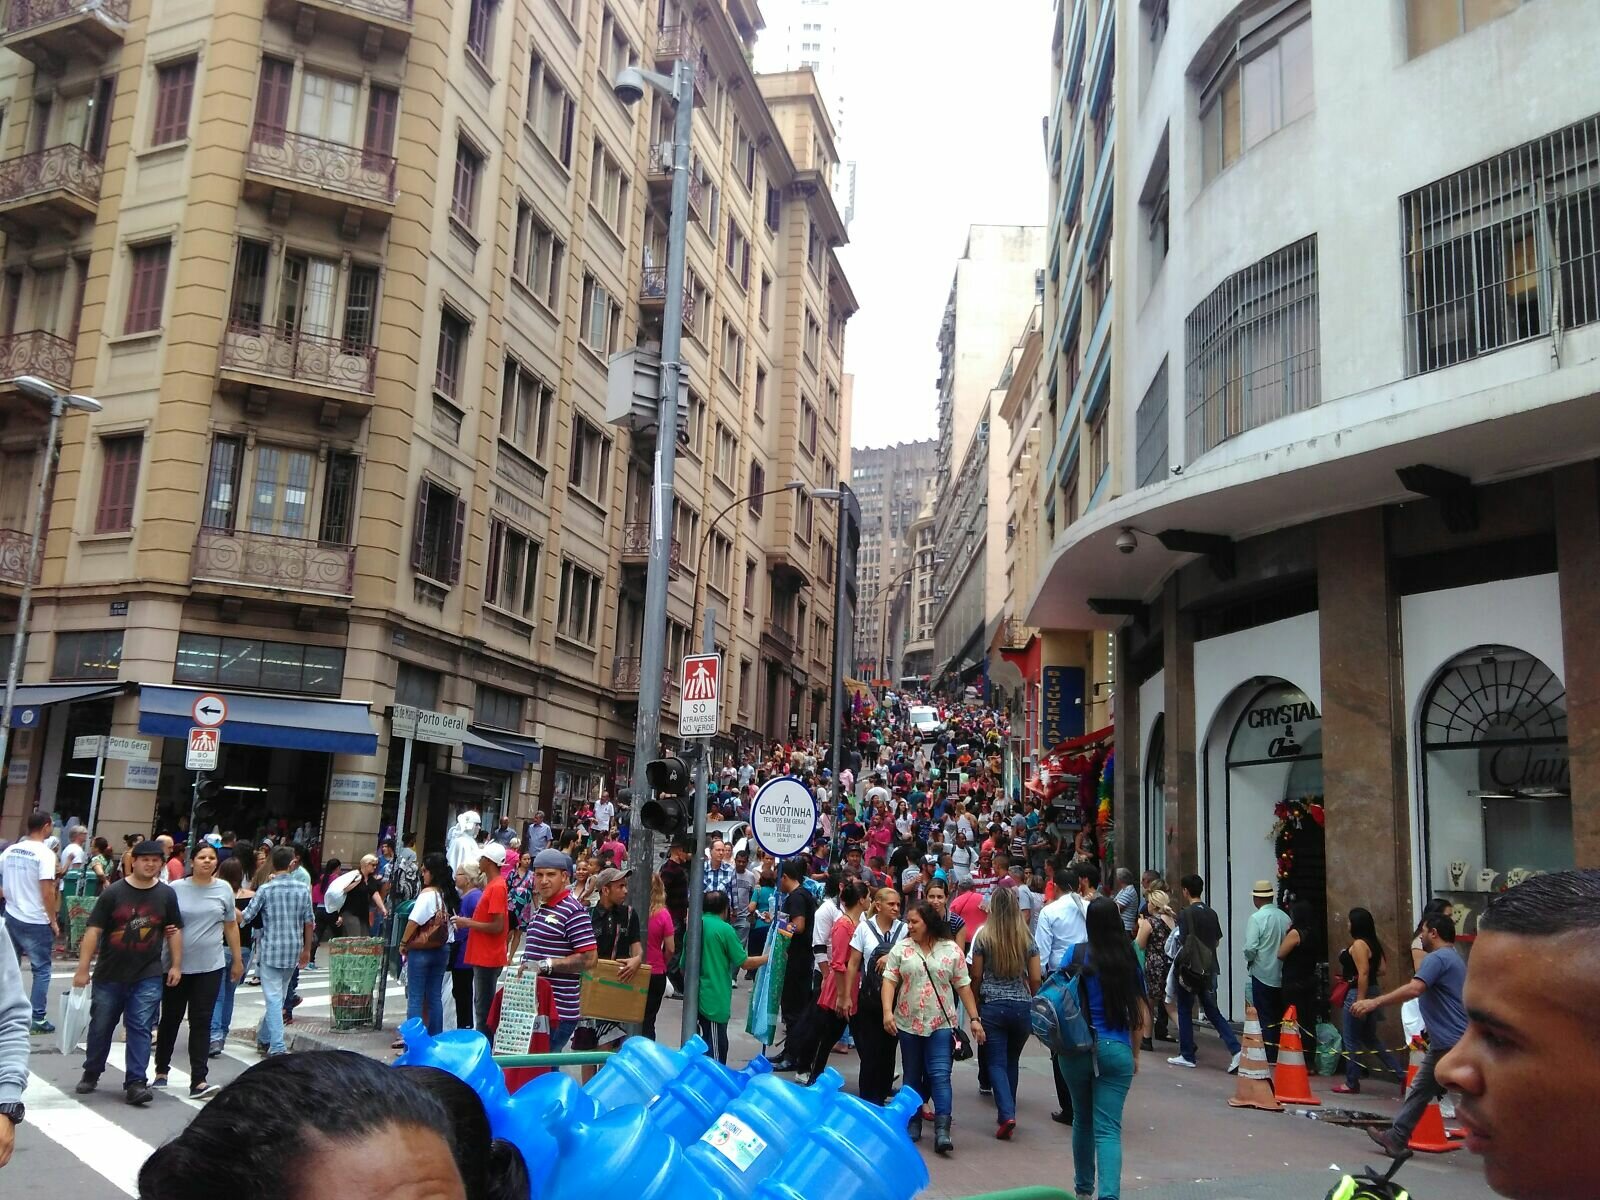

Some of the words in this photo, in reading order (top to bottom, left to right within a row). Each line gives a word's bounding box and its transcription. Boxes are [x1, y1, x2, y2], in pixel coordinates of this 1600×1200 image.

[692, 701, 706, 713] SÓ
[1047, 671, 1061, 744] BIJUTERIAS
[419, 711, 440, 726] Porto
[442, 715, 464, 730] Geral
[682, 714, 715, 723] ATRAVESSE
[1248, 701, 1321, 728] CRYSTAL
[694, 724, 714, 732] VERDE
[1285, 725, 1294, 737] &
[109, 738, 129, 748] Porto
[130, 741, 150, 751] Geral
[783, 794, 790, 804] A
[759, 804, 812, 818] GAIVOTINHA
